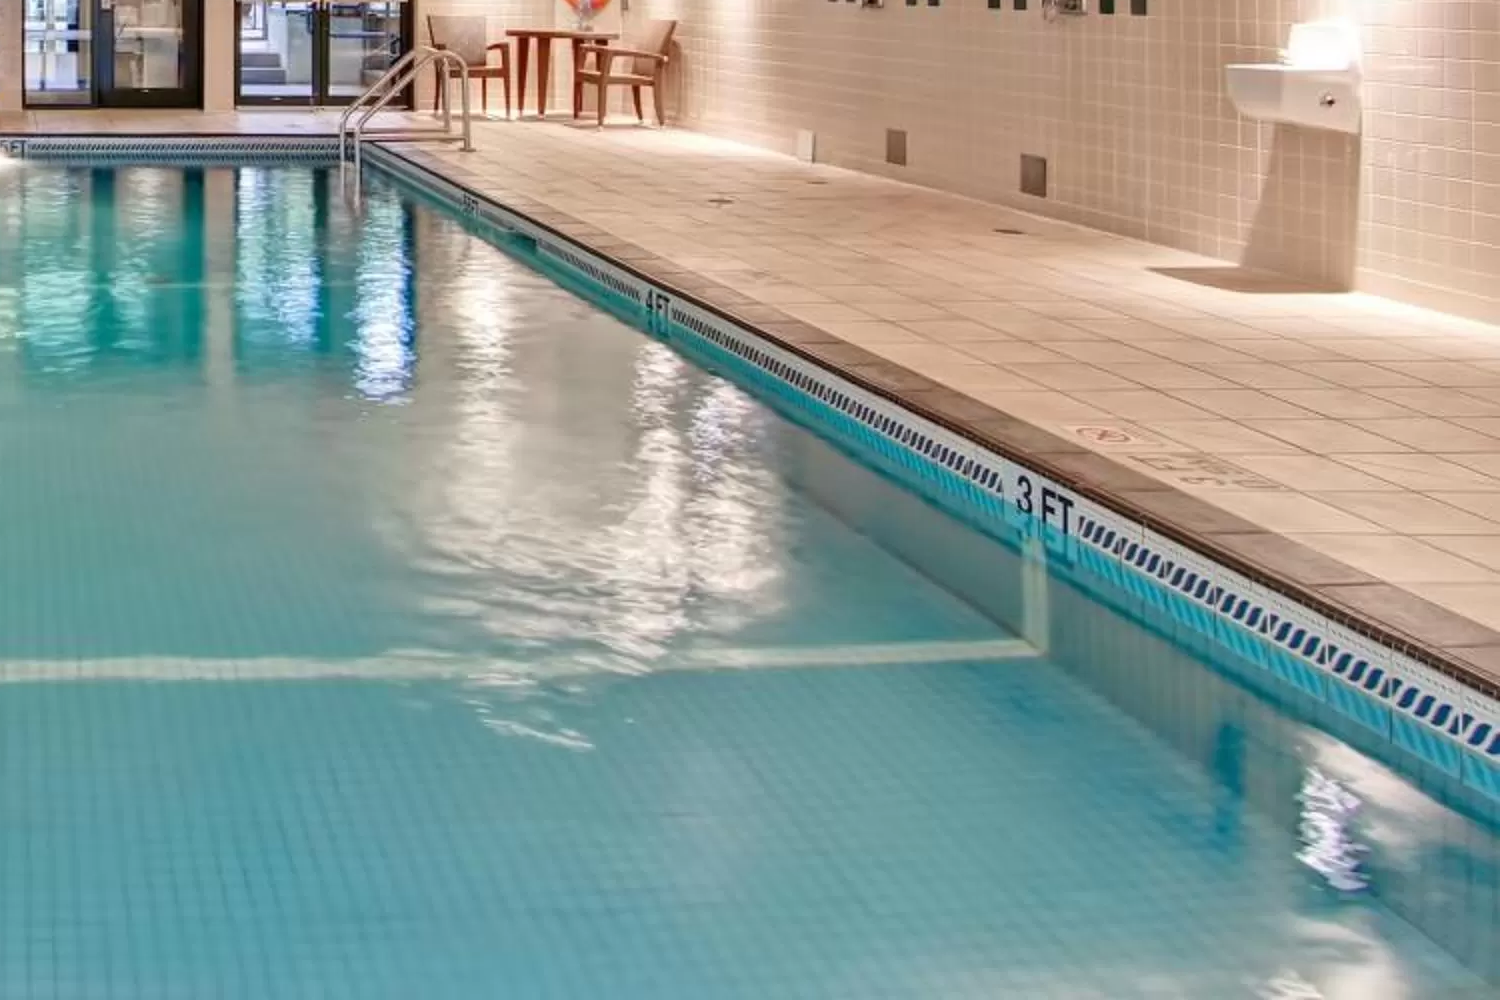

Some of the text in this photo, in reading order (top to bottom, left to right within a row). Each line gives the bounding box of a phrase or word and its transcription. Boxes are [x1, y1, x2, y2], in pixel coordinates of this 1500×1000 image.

[646, 289, 669, 317] 4 FT
[1016, 475, 1074, 534] 3 FT
